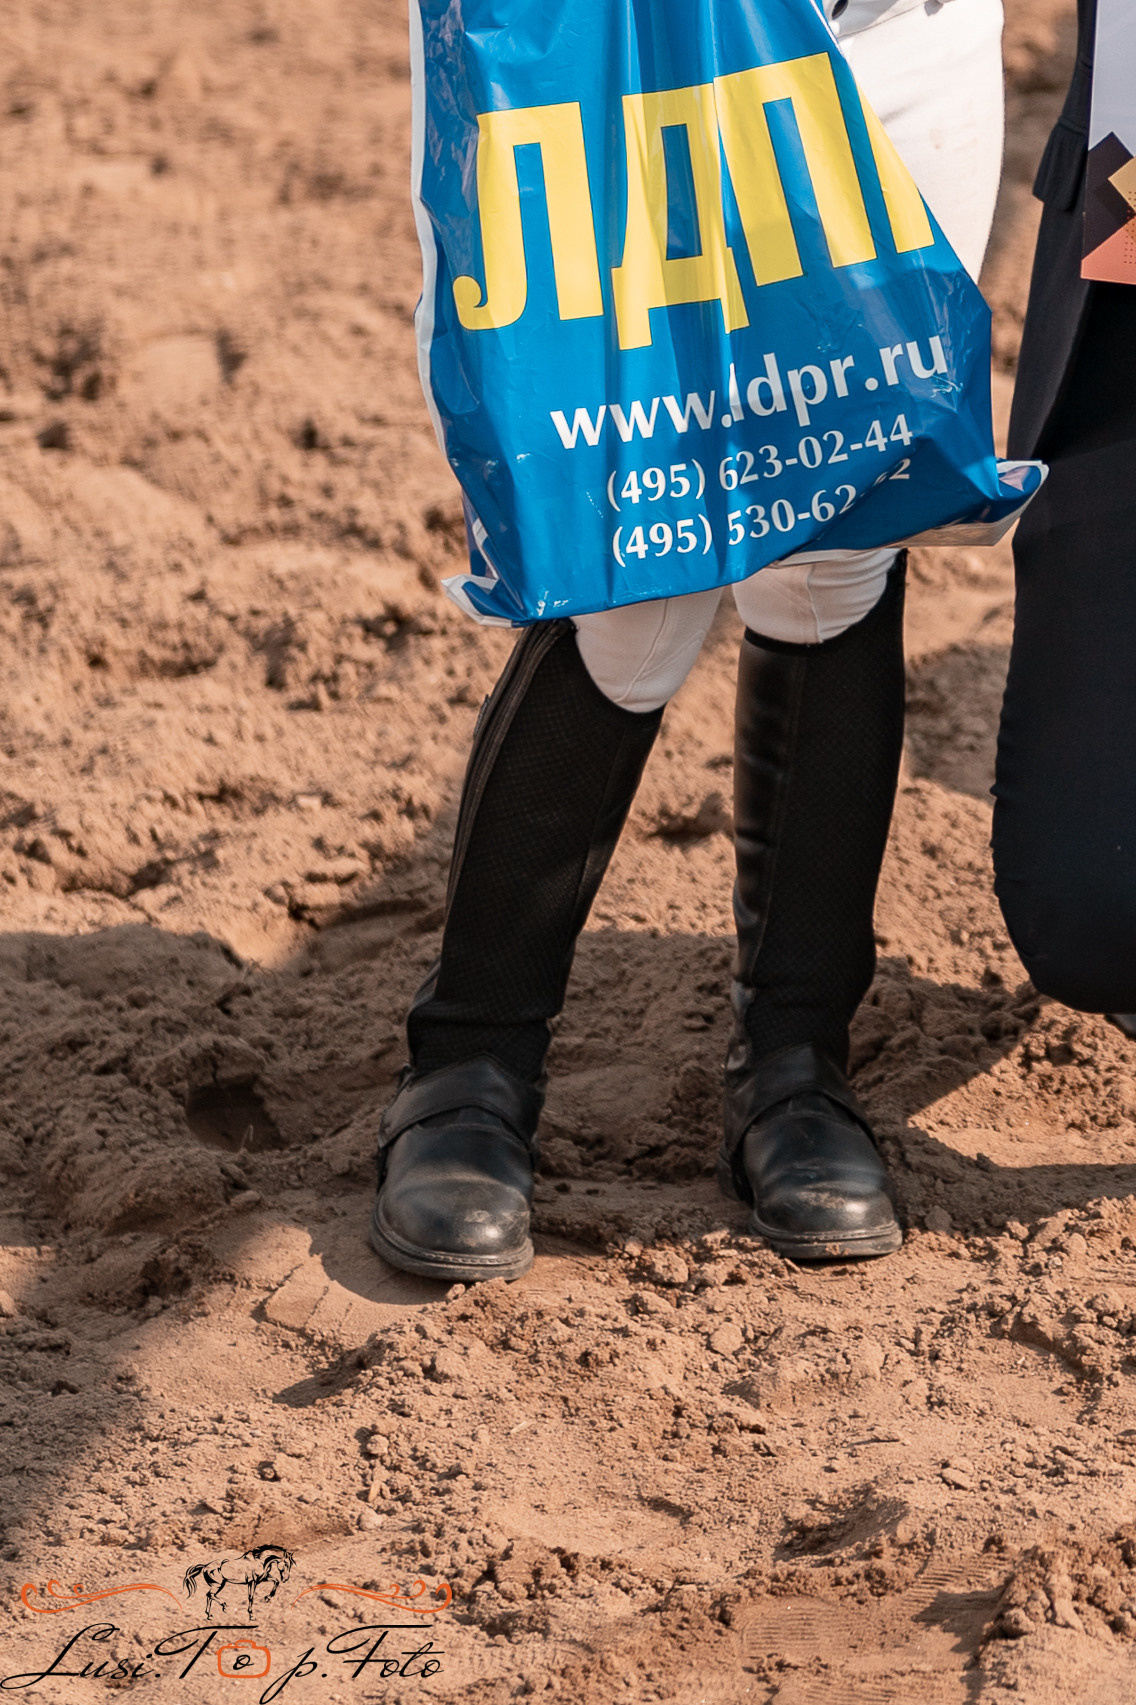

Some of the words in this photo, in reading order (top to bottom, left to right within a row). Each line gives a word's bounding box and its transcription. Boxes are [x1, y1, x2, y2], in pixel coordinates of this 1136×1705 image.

[549, 335, 949, 452] www.ldpr.ru
[606, 458, 706, 512] (495)
[718, 413, 914, 492] 623-02-44
[612, 513, 713, 568] (495)
